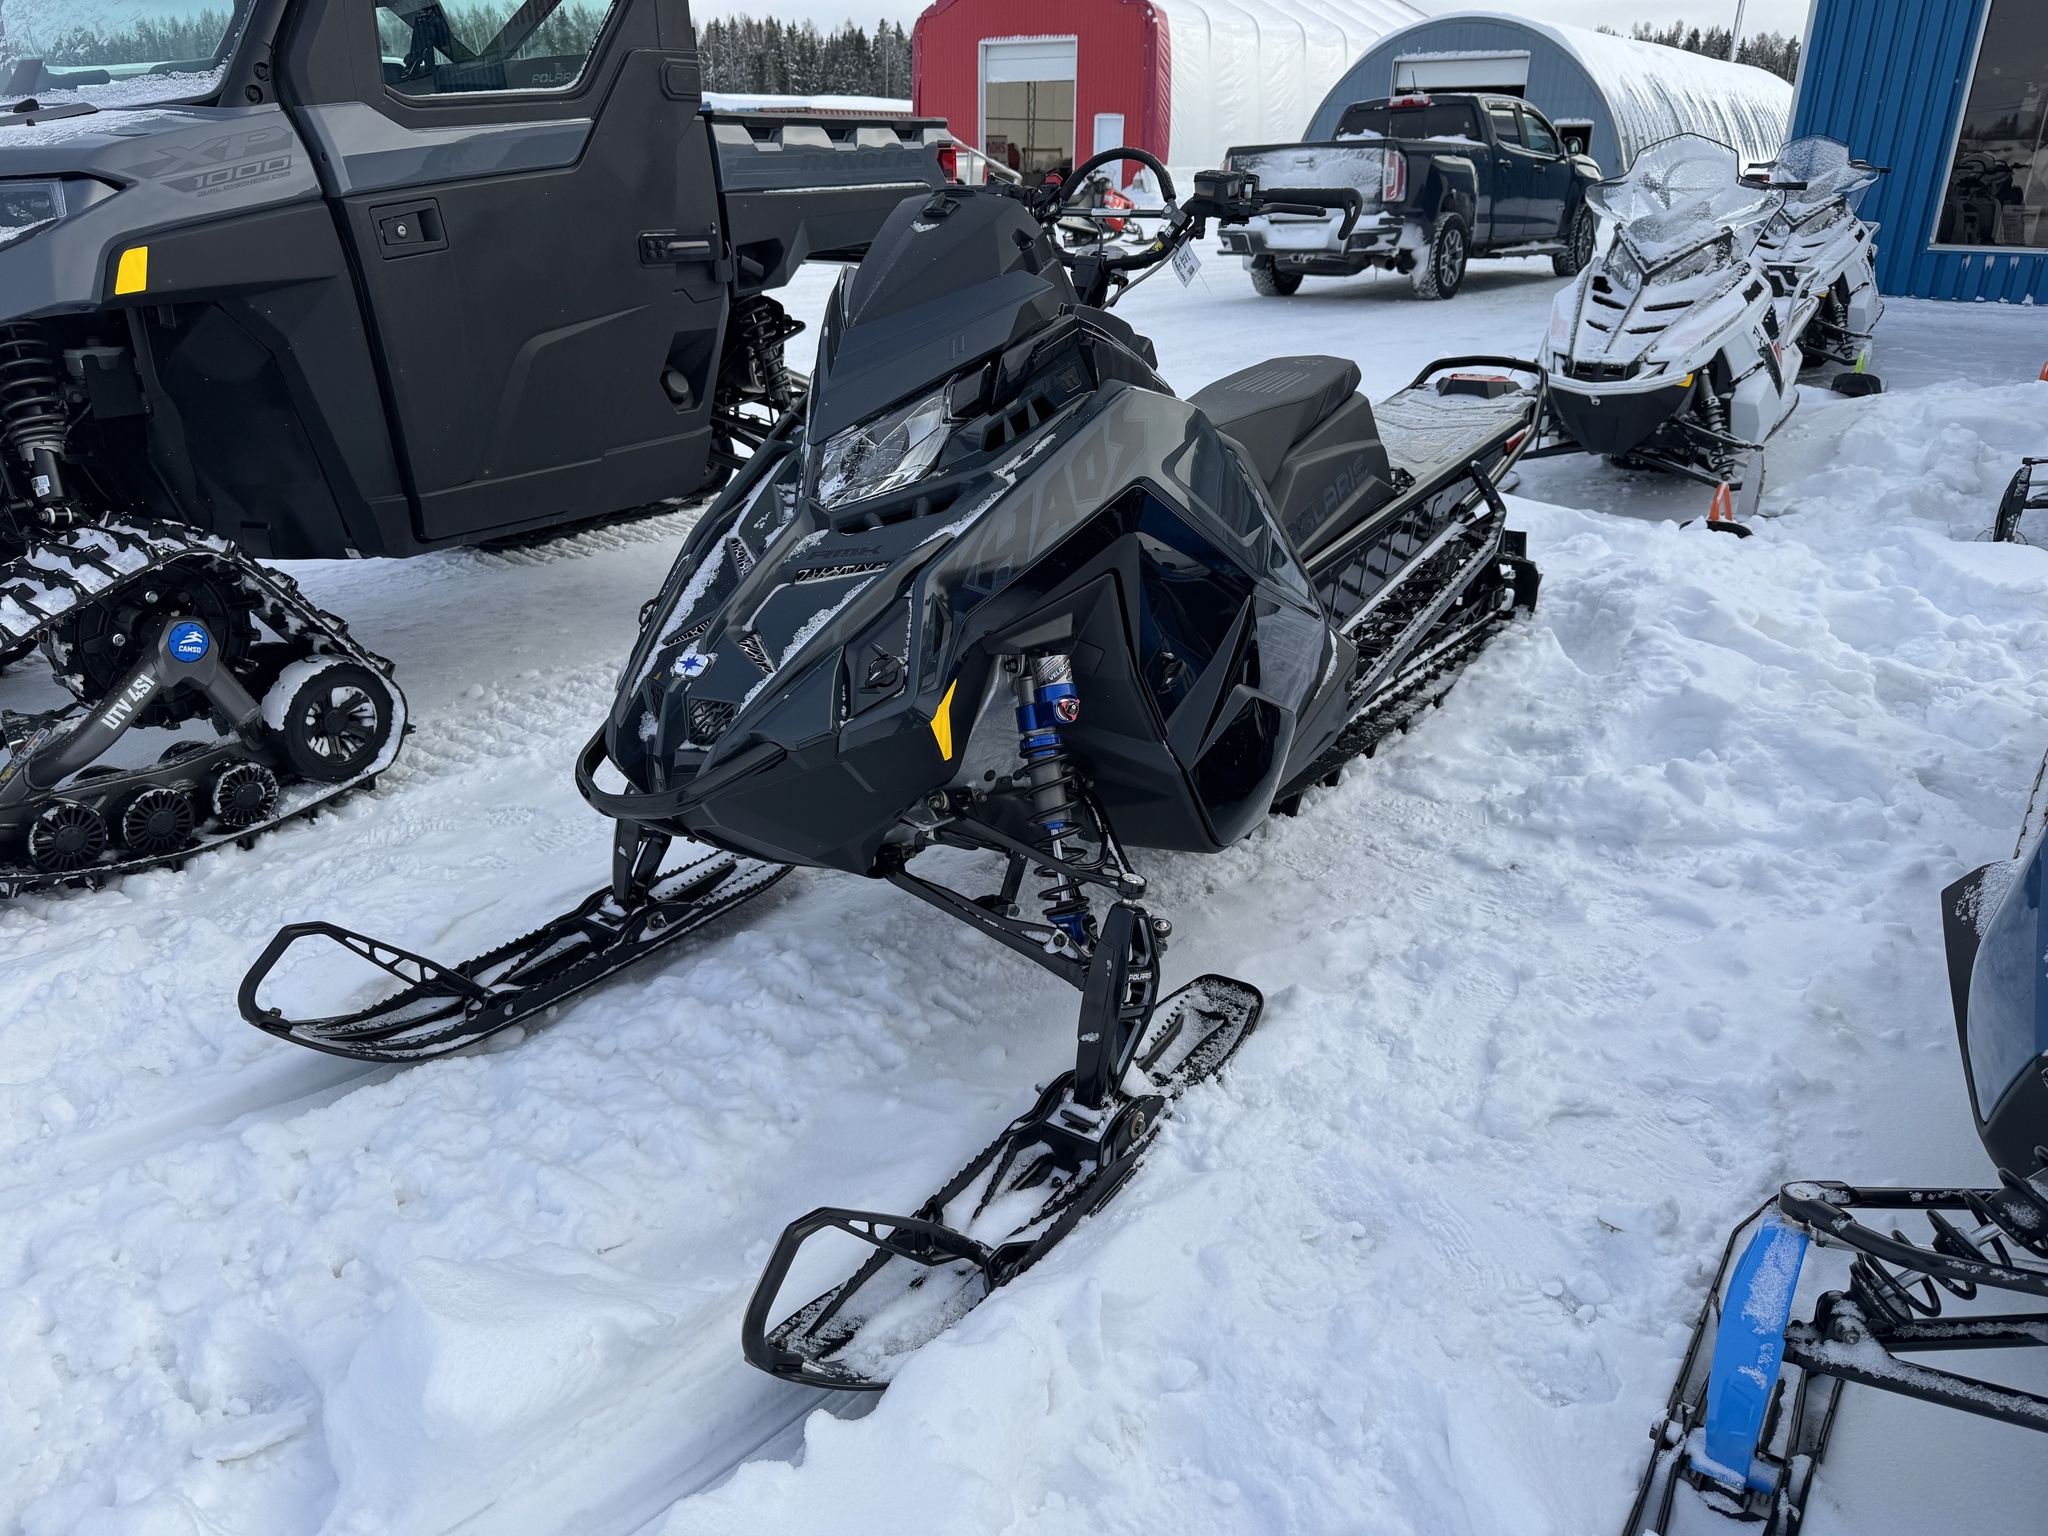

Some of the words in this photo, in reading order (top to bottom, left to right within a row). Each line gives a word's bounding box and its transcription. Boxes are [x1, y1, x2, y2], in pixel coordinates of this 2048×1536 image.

[531, 71, 577, 84] POLARI
[152, 125, 293, 177] XP
[802, 149, 914, 172] RANGER
[194, 156, 291, 190] 1000
[196, 186, 222, 198] DUAL
[223, 175, 270, 191] OVERHEAD
[271, 170, 291, 180] CAM
[1285, 454, 1368, 541] POLARIS
[806, 544, 884, 561] RMK
[178, 645, 202, 654] CAMSO
[100, 697, 133, 730] UTV
[126, 672, 157, 703] 4S1
[1128, 971, 1152, 982] POLARIS
